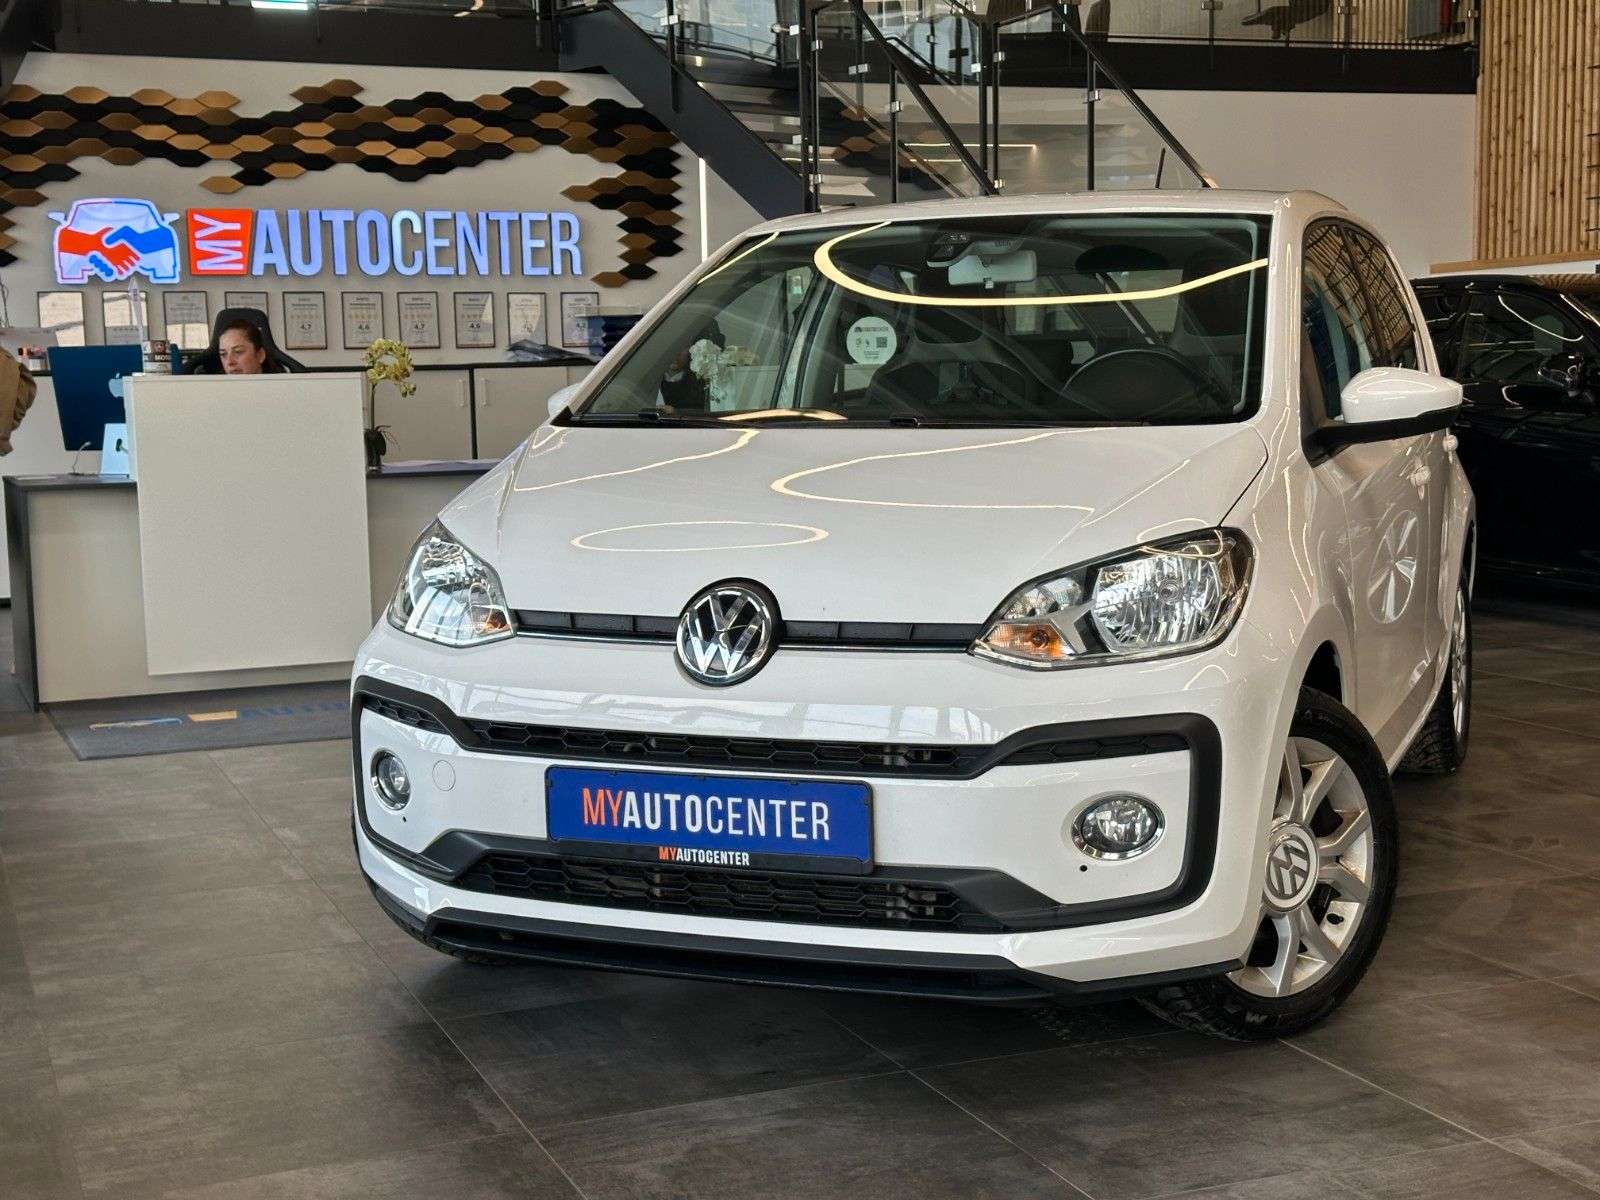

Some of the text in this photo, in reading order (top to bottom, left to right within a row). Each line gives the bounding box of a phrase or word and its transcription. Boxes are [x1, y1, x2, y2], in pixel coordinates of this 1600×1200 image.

[193, 208, 583, 276] MY AUTOCENTER
[581, 787, 830, 841] MYAUTOCENTER
[657, 846, 750, 867] MYAUTOCENTER
